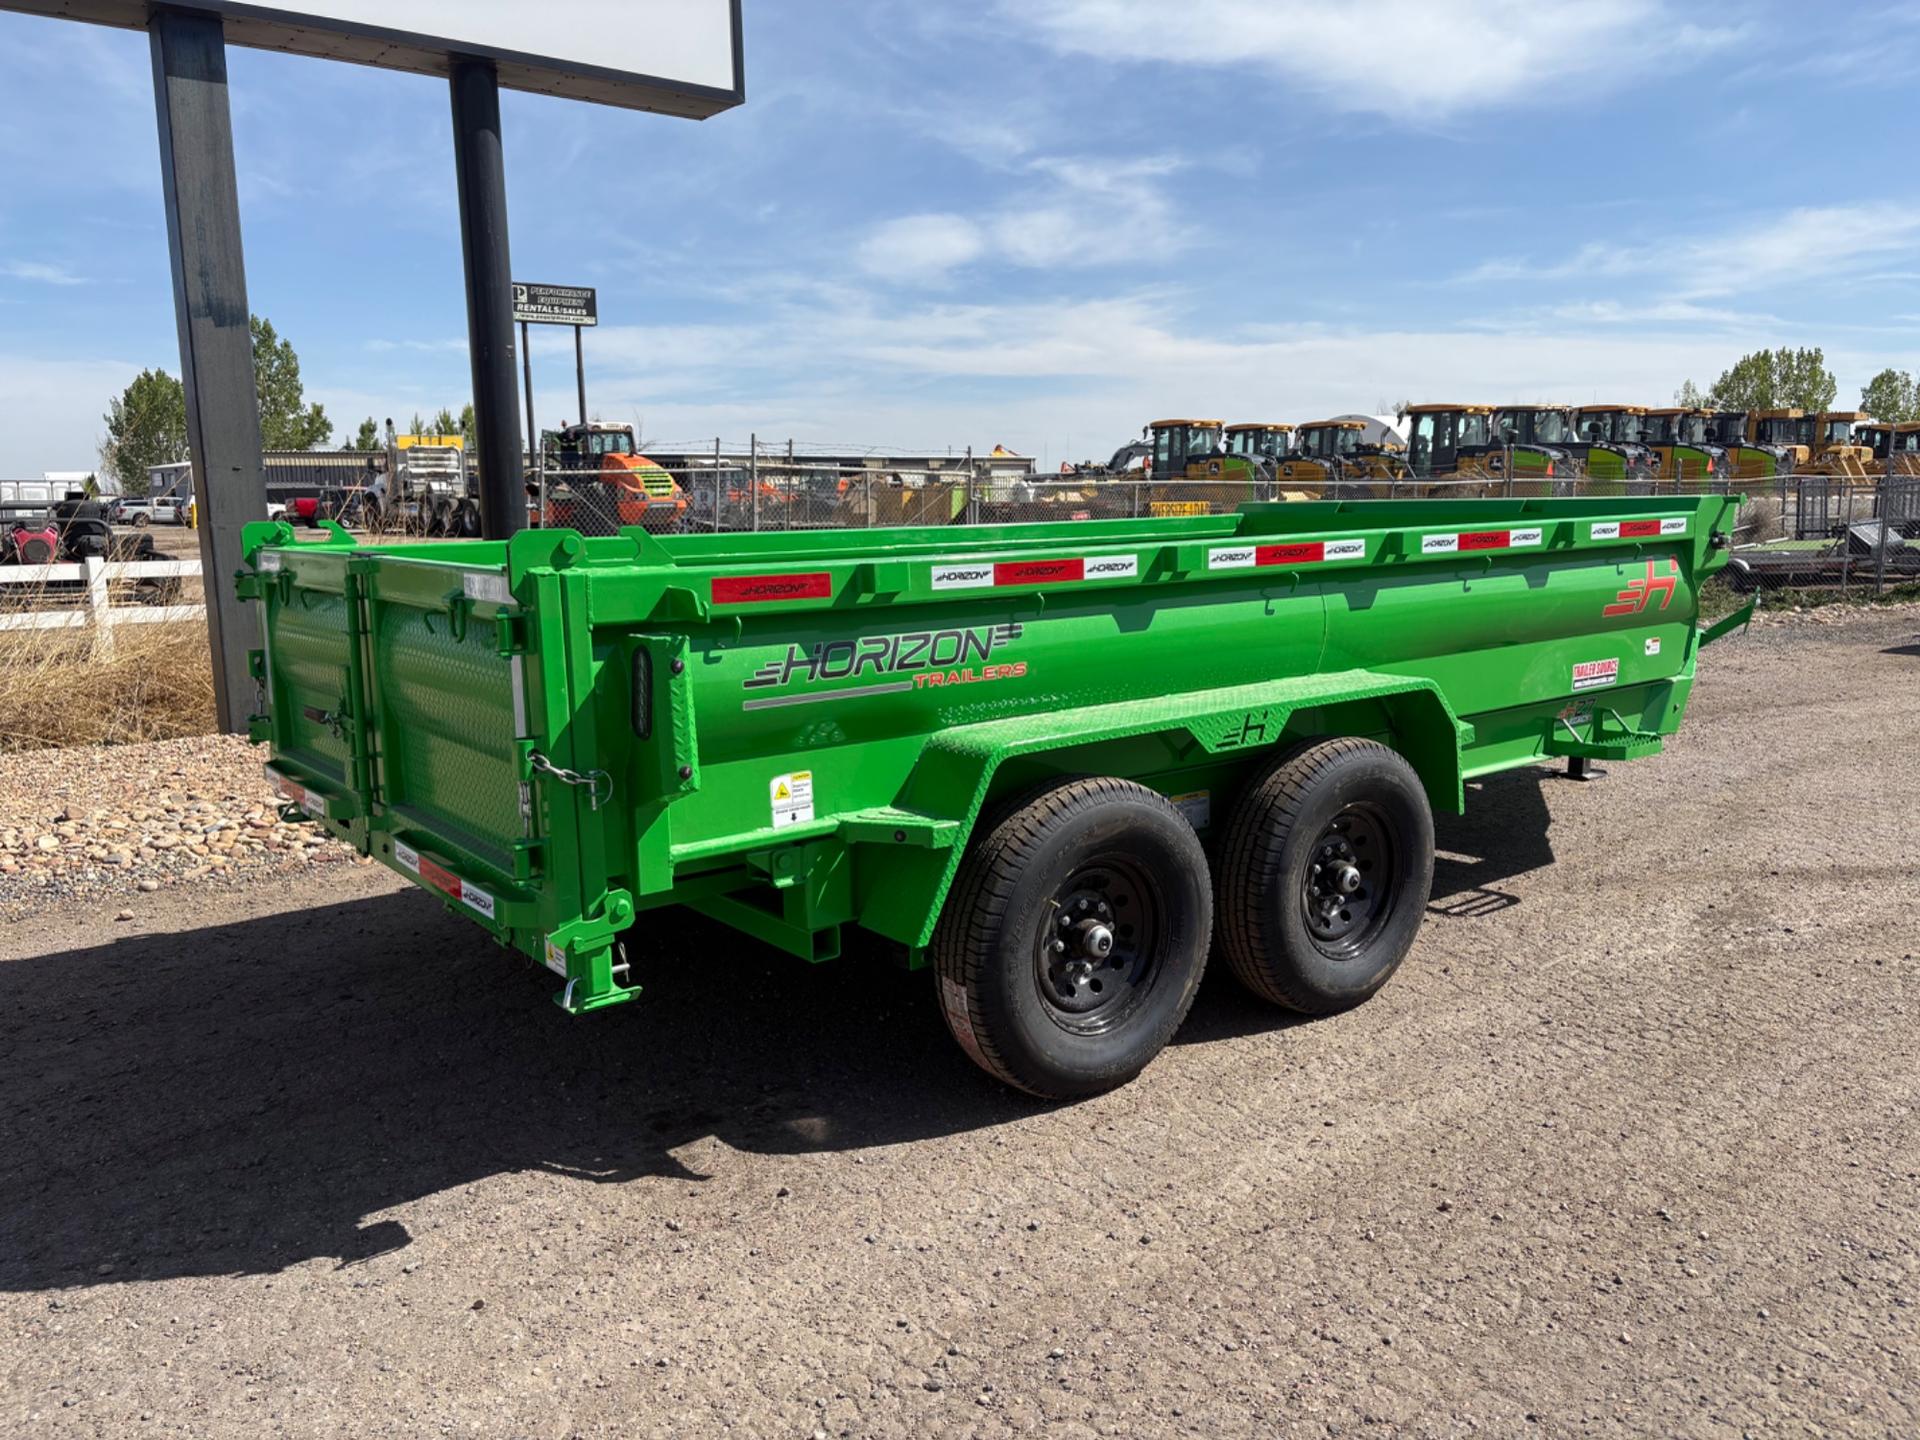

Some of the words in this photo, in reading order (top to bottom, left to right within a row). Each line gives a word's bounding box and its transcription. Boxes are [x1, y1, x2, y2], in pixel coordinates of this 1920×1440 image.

[537, 296, 586, 307] EQUIPMENT
[1331, 544, 1359, 554] HORIZON
[1215, 552, 1248, 562] HORIZON
[1091, 562, 1130, 572] HORIZON
[940, 571, 986, 582] HORIZON
[749, 584, 804, 595] HORIZON
[780, 626, 996, 685] HORIZON
[912, 661, 1028, 689] TRAILERS
[1574, 663, 1595, 678] TRAILER
